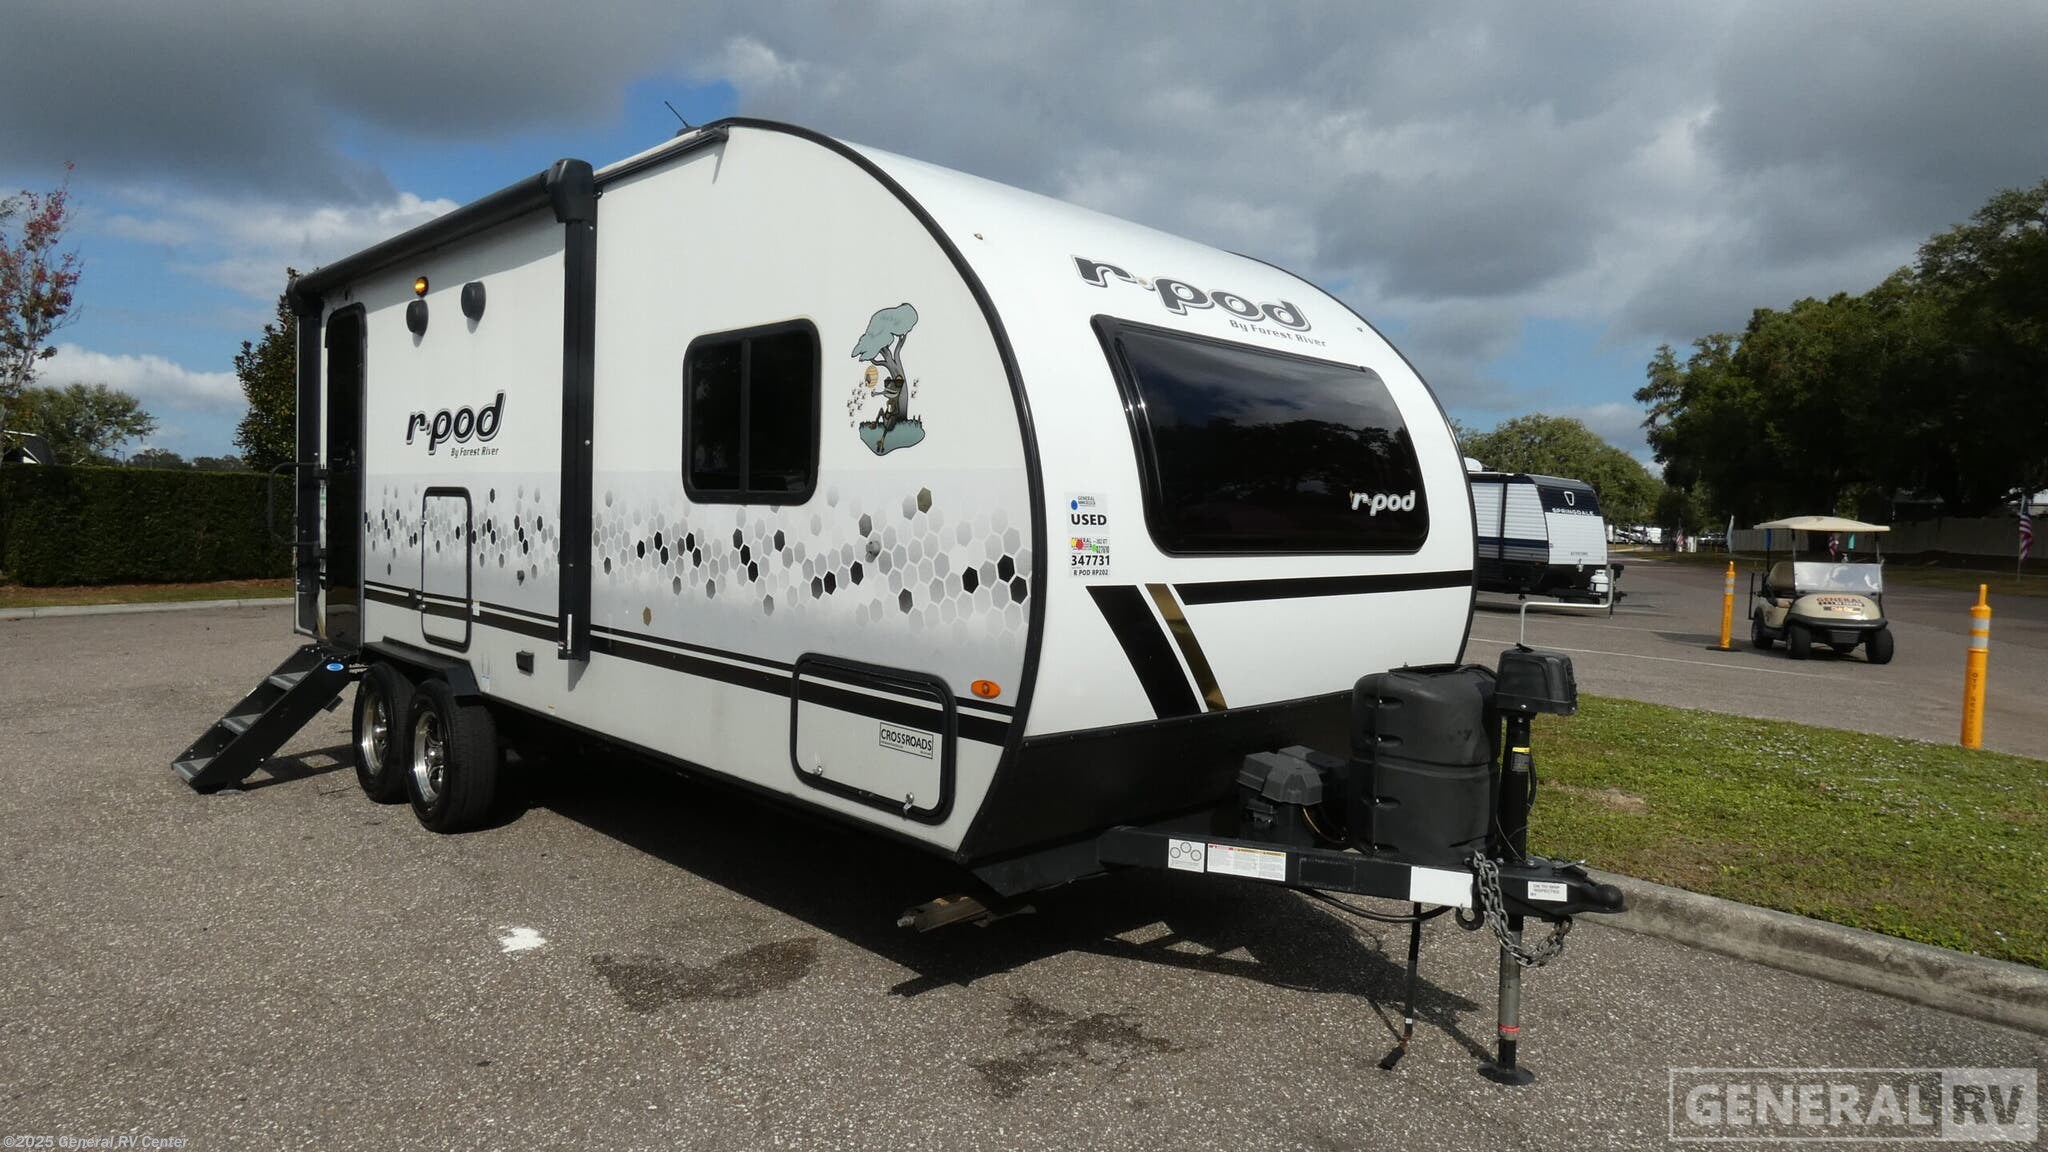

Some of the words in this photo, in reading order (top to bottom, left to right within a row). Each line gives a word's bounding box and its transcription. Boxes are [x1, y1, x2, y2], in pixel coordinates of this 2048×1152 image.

[1229, 319, 1249, 332] By
[1250, 324, 1293, 339] Forest
[1294, 333, 1327, 347] River
[451, 447, 459, 458] By
[459, 447, 480, 456] Forest
[481, 446, 499, 456] River
[1551, 507, 1595, 517] SPRINGDALE
[1071, 513, 1107, 526] USED
[1071, 555, 1110, 566] 347731
[1079, 569, 1091, 577] POD
[881, 728, 932, 752] CROSSROADS
